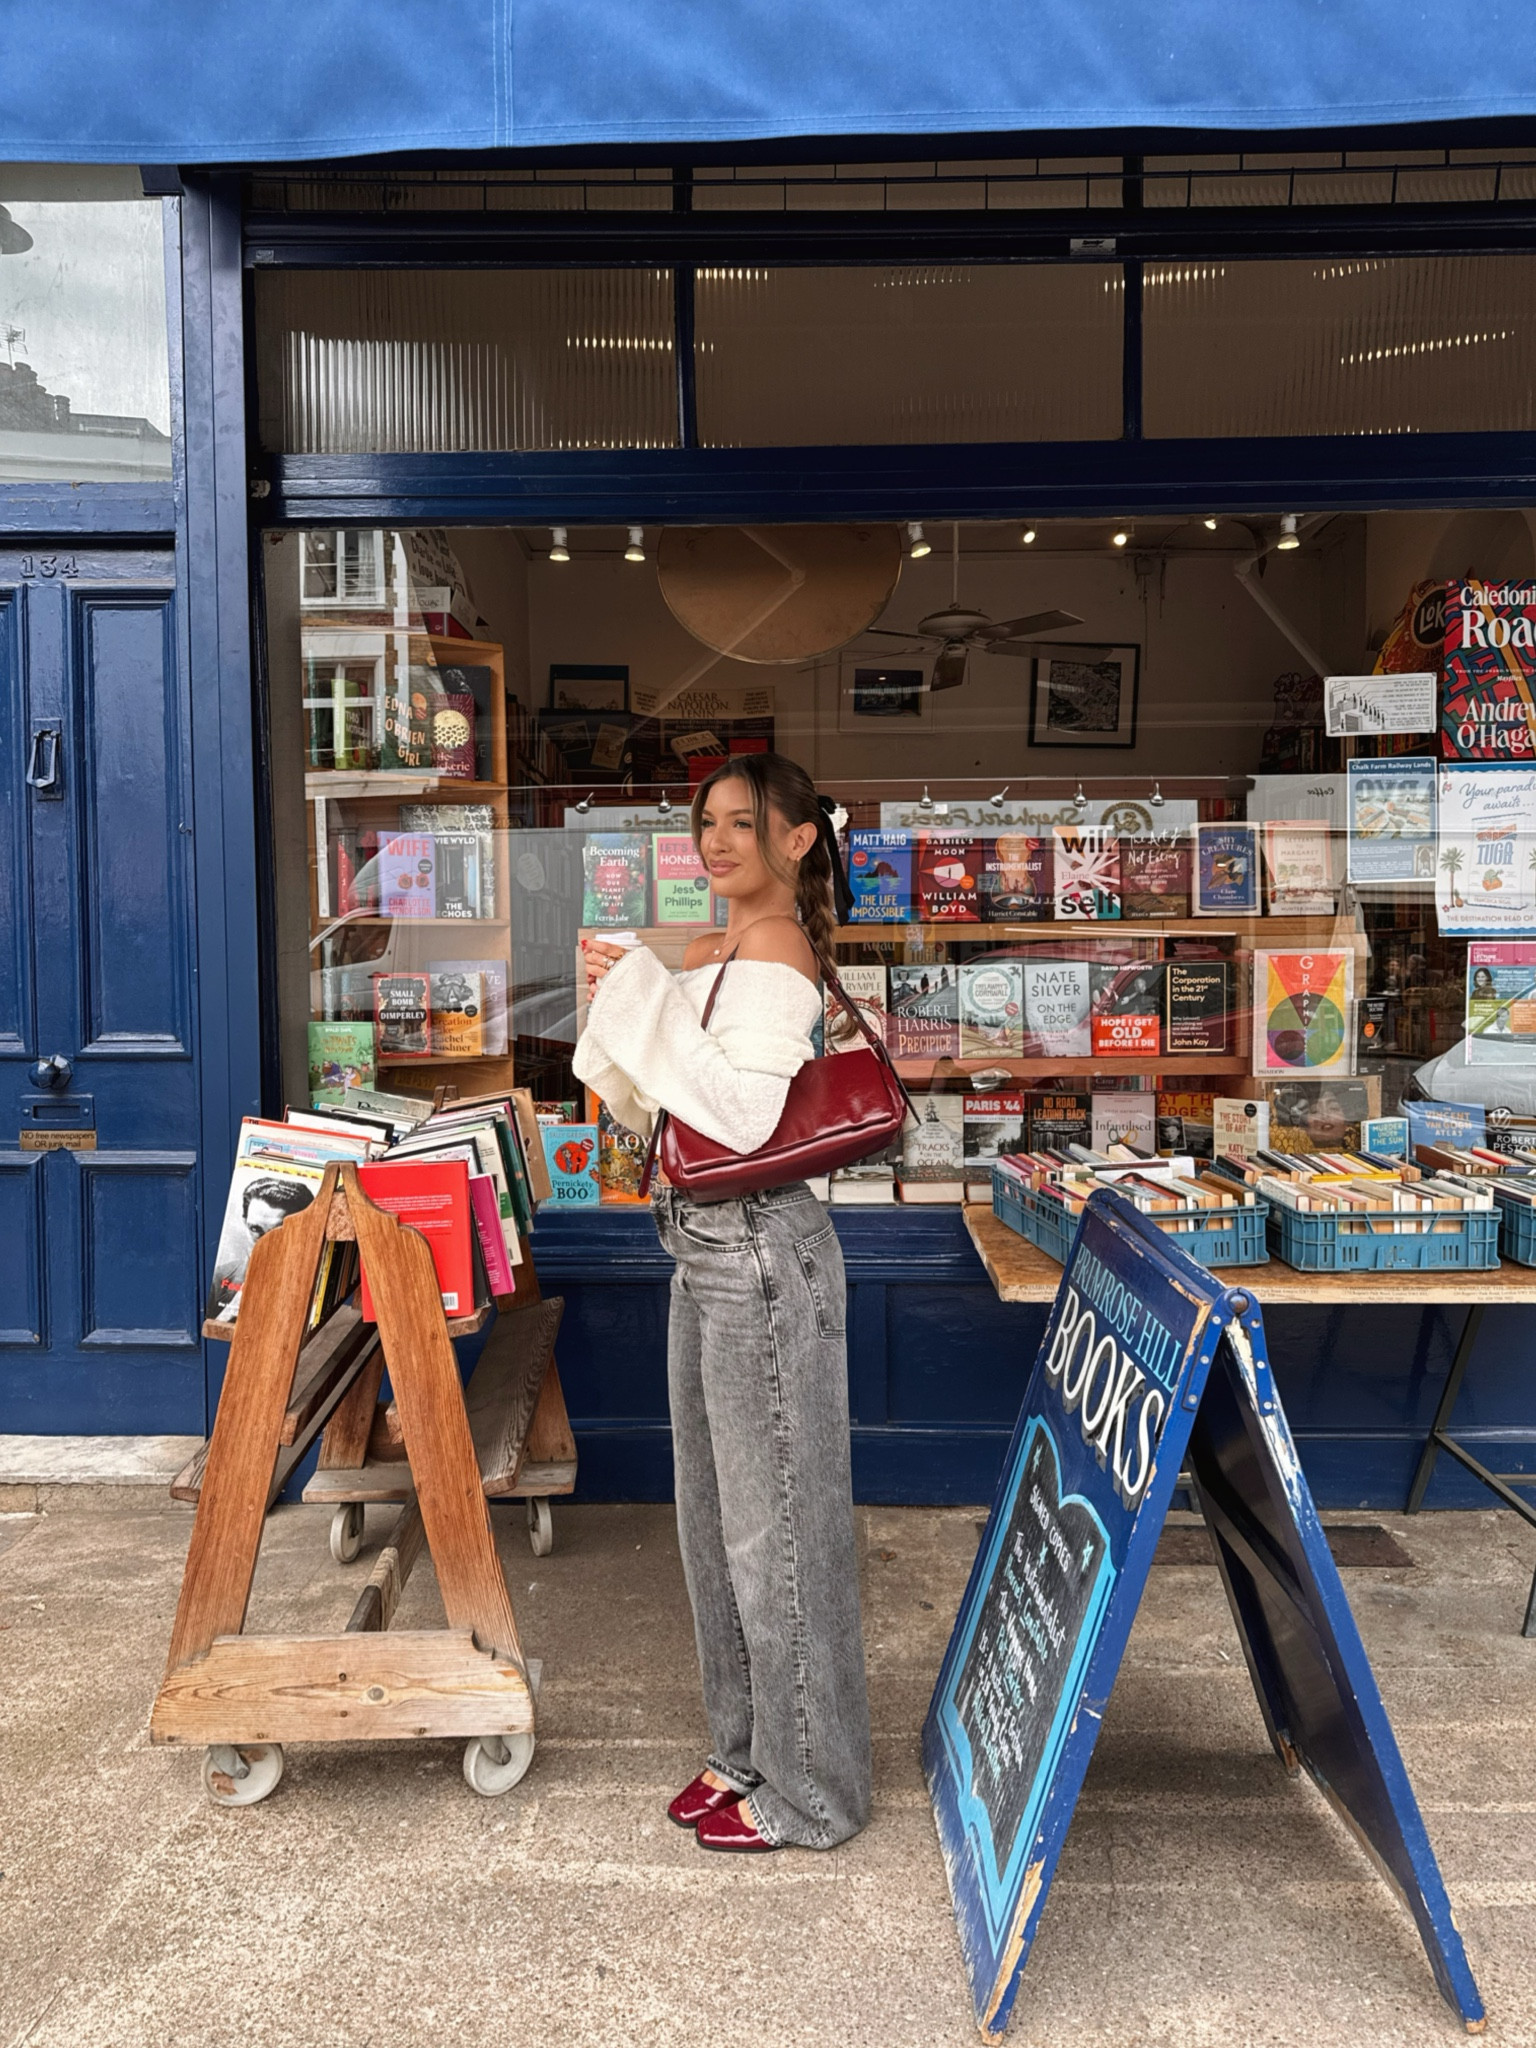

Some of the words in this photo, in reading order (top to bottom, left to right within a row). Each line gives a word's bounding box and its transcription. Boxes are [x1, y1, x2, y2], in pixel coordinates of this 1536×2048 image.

[20, 555, 79, 579] 134
[385, 695, 413, 720] EDNA
[385, 717, 425, 746] O'BRIEN
[398, 745, 421, 767] GIRL
[1388, 762, 1412, 770] Railway
[1414, 761, 1431, 769] Lands
[1459, 783, 1492, 810] Your
[1483, 796, 1520, 811] awaits
[450, 837, 476, 845] WYLD
[853, 833, 880, 846] MATT
[882, 833, 907, 846] HAIG
[926, 837, 974, 845] GABRIEL'S
[1062, 829, 1112, 854] will
[1218, 836, 1236, 844] SHY
[387, 837, 430, 857] WIFE
[590, 846, 640, 858] Becoming
[660, 842, 688, 853] LET'S
[1201, 840, 1253, 856] CREATURES
[1008, 853, 1019, 861] THE
[1476, 841, 1514, 866] TUGA
[599, 856, 629, 867] Earth
[659, 855, 700, 866] HONES
[1128, 851, 1144, 866] Not
[1148, 850, 1182, 870] Eating
[985, 862, 1042, 872] INSTRUMENTALIST
[1060, 871, 1090, 881] Elaine
[672, 885, 695, 895] Jess
[860, 895, 877, 906] THE
[879, 894, 897, 905] LIFE
[922, 892, 977, 901] WILLIAM
[1060, 890, 1117, 914] self
[445, 902, 463, 910] THE
[664, 896, 703, 909] Phillips
[436, 910, 472, 919] ECHOES
[851, 906, 905, 918] IMPOSSIBLE
[932, 905, 967, 914] BOYD
[1460, 914, 1502, 922] DESTINATION
[1504, 914, 1522, 922] READ
[1036, 971, 1076, 984] NATE
[1172, 968, 1188, 976] The
[1172, 976, 1221, 986] Corporation
[390, 990, 415, 998] SMALL
[1031, 984, 1081, 997] SILVER
[1172, 985, 1180, 993] in
[1181, 985, 1194, 993] the
[391, 998, 414, 1006] BOMB
[1172, 994, 1206, 1003] Century
[897, 1004, 950, 1018] ROBERT
[1037, 1004, 1055, 1013] ON
[1058, 1003, 1077, 1012] THE
[380, 1011, 425, 1021] DIMPERLEY
[1043, 1014, 1072, 1024] EDGE
[898, 1018, 952, 1033] HARRIS
[1101, 1018, 1127, 1027] HOPE
[1134, 1017, 1153, 1026] GET
[1111, 1026, 1143, 1040] OLD
[898, 1034, 952, 1055] PRECIPICE
[1098, 1039, 1132, 1048] BEFORE
[1140, 1039, 1156, 1047] DIE
[1171, 1037, 1192, 1047] John
[1193, 1037, 1210, 1048] Kay
[1043, 1096, 1054, 1109] NO
[1055, 1096, 1077, 1109] ROAD
[1158, 1093, 1176, 1106] AT
[965, 1100, 1001, 1112] PARIS
[1003, 1100, 1021, 1112] '44
[1033, 1108, 1065, 1120] LEADING
[1066, 1108, 1087, 1121] BACK
[1158, 1106, 1198, 1118] EDGE
[1220, 1112, 1231, 1121] THE
[1425, 1109, 1471, 1120] VINCENT
[1095, 1120, 1151, 1132] Infantilised
[1225, 1122, 1233, 1133] OF
[1234, 1124, 1246, 1134] ART
[1372, 1123, 1403, 1131] MURDER
[1425, 1121, 1442, 1130] VAN
[1443, 1119, 1473, 1130] GOGH
[50, 1133, 95, 1141] newspapers
[1435, 1129, 1464, 1137] ATLAS
[34, 1140, 47, 1148] OR
[48, 1140, 63, 1149] junk
[1388, 1137, 1403, 1145] SUN
[1496, 1134, 1536, 1145] ROBERT
[917, 1143, 950, 1151] TRACKS
[917, 1158, 949, 1166] OCEAN
[552, 1180, 594, 1189] Pernickety
[557, 1188, 589, 1199] BOO
[1070, 1242, 1143, 1346] PRIMROSE
[1135, 1311, 1182, 1393] HILL
[1045, 1285, 1166, 1496] BOOKS
[1030, 1484, 1050, 1530] SIGNED
[1049, 1525, 1071, 1573] COPIES
[1013, 1531, 1025, 1563] The
[1023, 1551, 1066, 1658] Instrumentalist
[1000, 1591, 1009, 1620] The
[1004, 1553, 1025, 1605] Harriet
[1020, 1597, 1049, 1665] Constable
